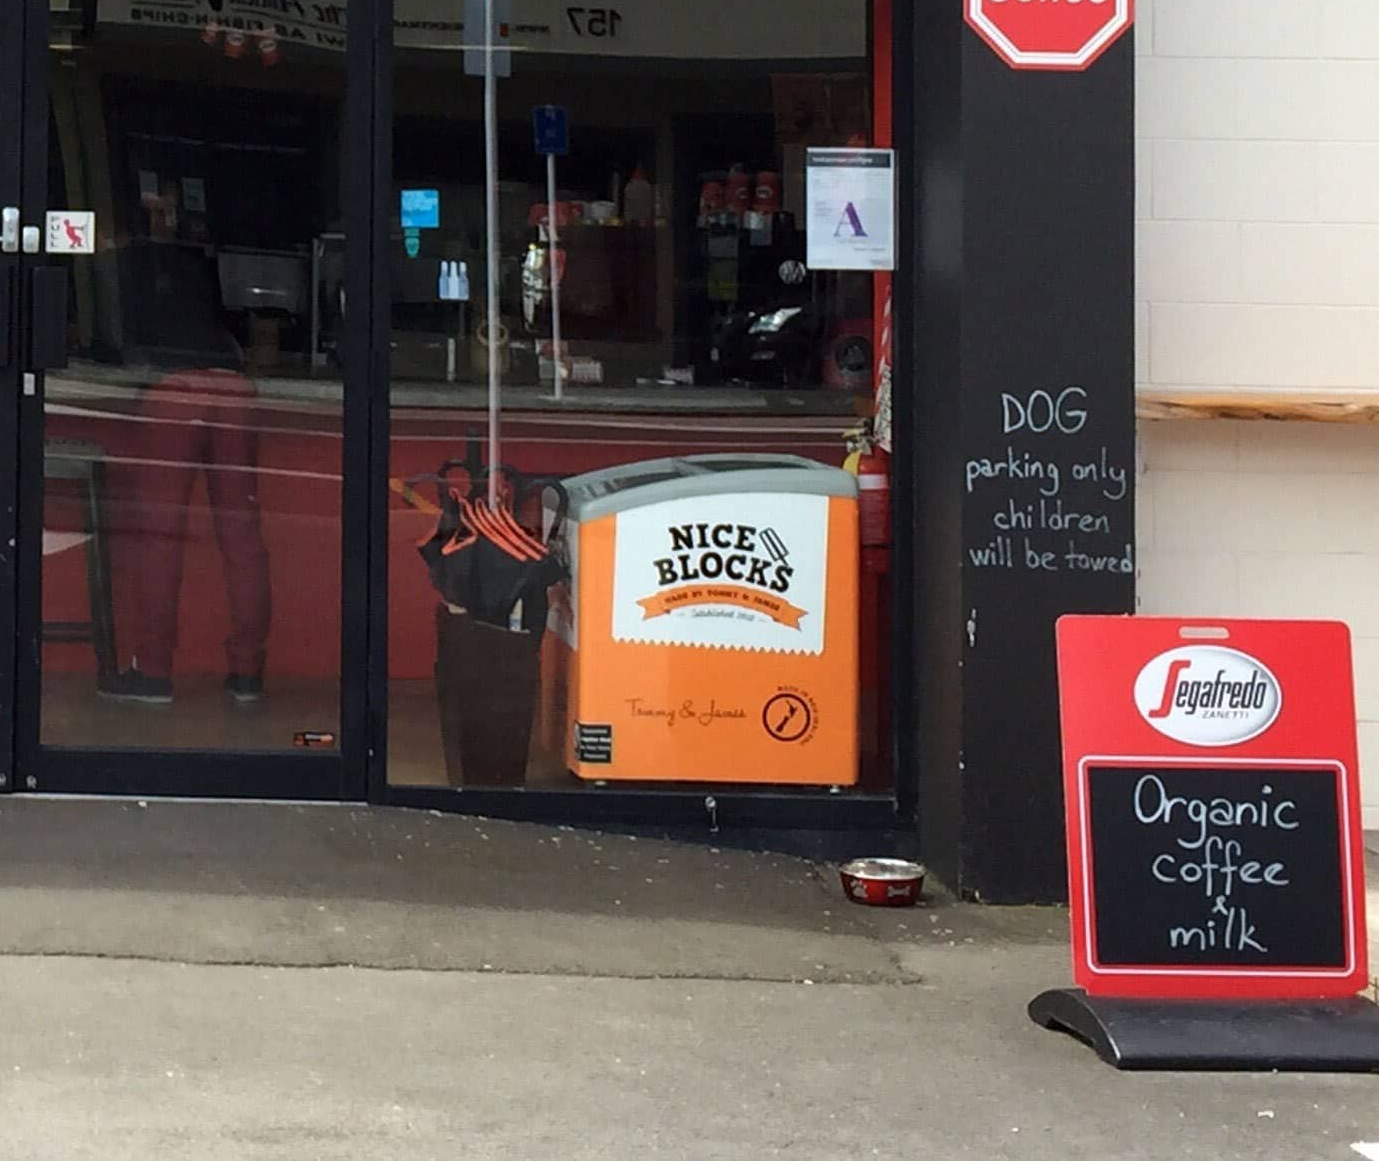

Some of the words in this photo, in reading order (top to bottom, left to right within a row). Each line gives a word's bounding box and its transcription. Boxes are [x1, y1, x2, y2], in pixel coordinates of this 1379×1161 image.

[832, 201, 869, 238] A
[1001, 387, 1087, 434] DOG
[966, 445, 1059, 497] parking
[1071, 446, 1127, 501] only
[668, 522, 757, 552] NICE
[993, 498, 1110, 533] children
[652, 551, 795, 594] BLOCKS
[969, 535, 1013, 568] will
[1024, 537, 1059, 571] be
[1064, 540, 1133, 573] towed
[1148, 659, 1268, 718] Segafredo
[1202, 710, 1250, 719] ZANETTI
[1133, 774, 1300, 848] Organic
[1151, 836, 1291, 897] coffee
[1169, 907, 1268, 952] milk
